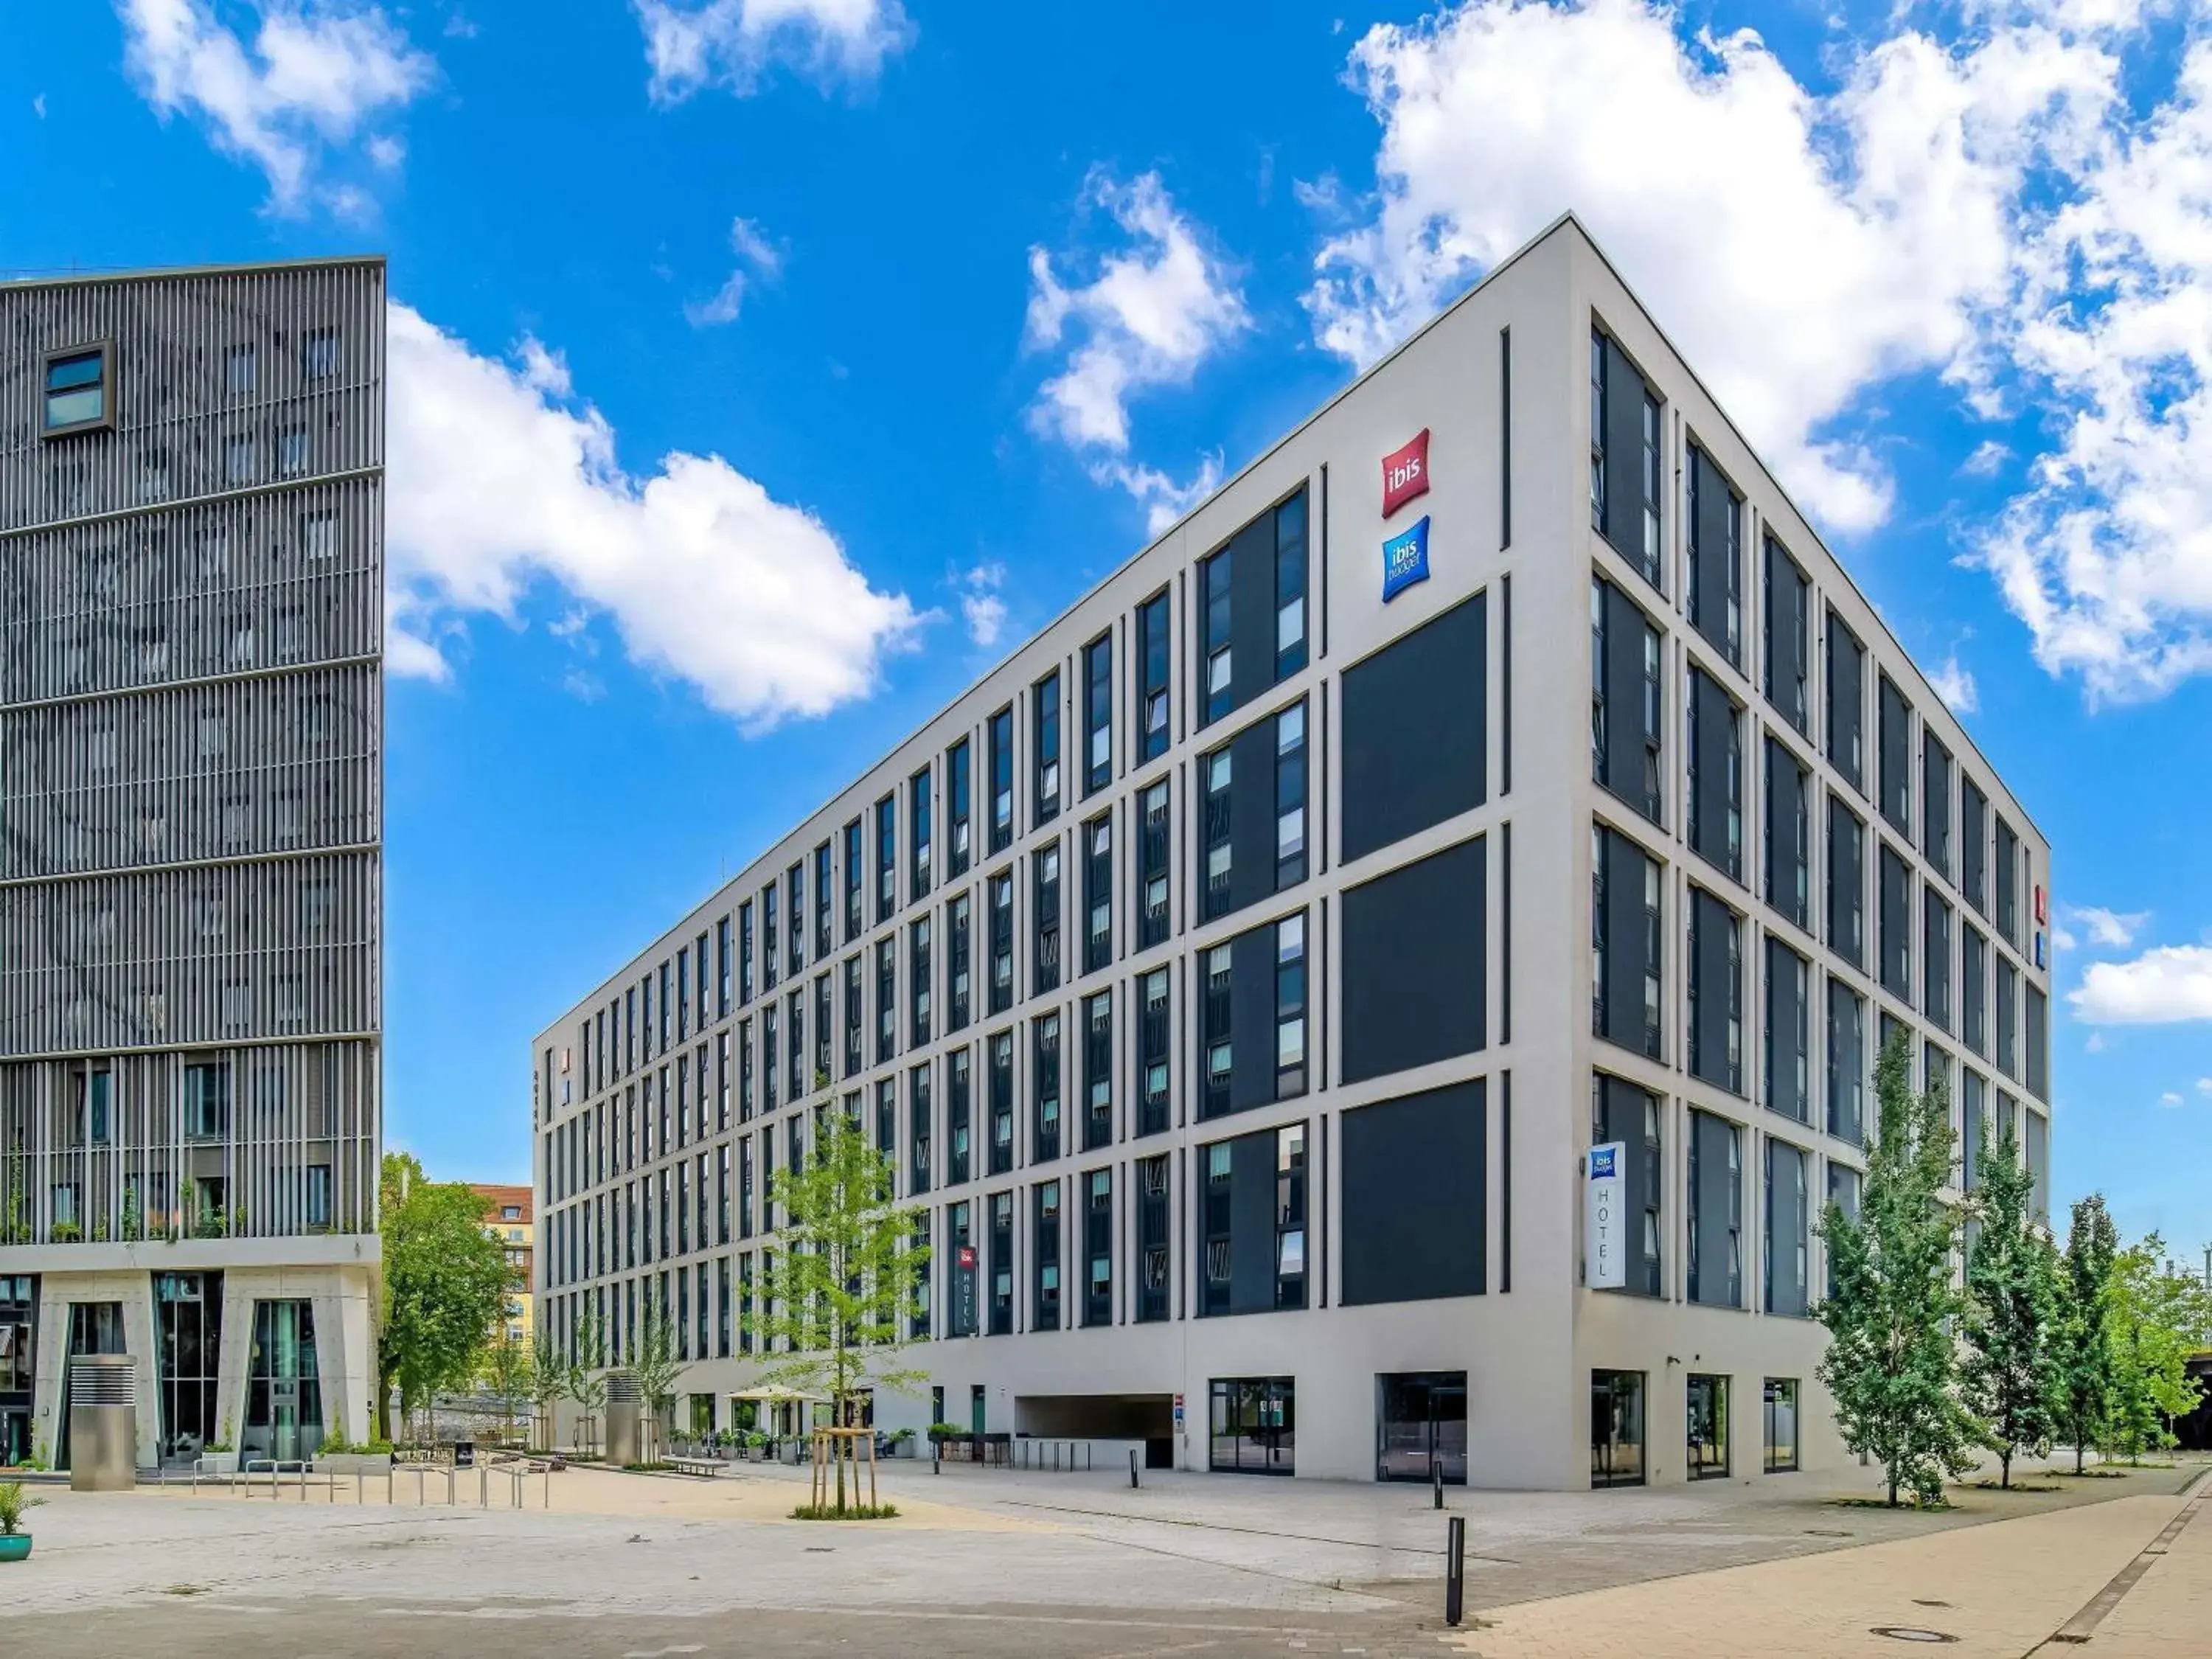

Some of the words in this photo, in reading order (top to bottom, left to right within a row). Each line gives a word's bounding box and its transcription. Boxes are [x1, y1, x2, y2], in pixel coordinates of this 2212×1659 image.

[1388, 458, 1420, 493] ibis
[1388, 552, 1420, 580] budget
[1392, 540, 1416, 566] ibis
[1599, 1189, 1608, 1276] HOTEL
